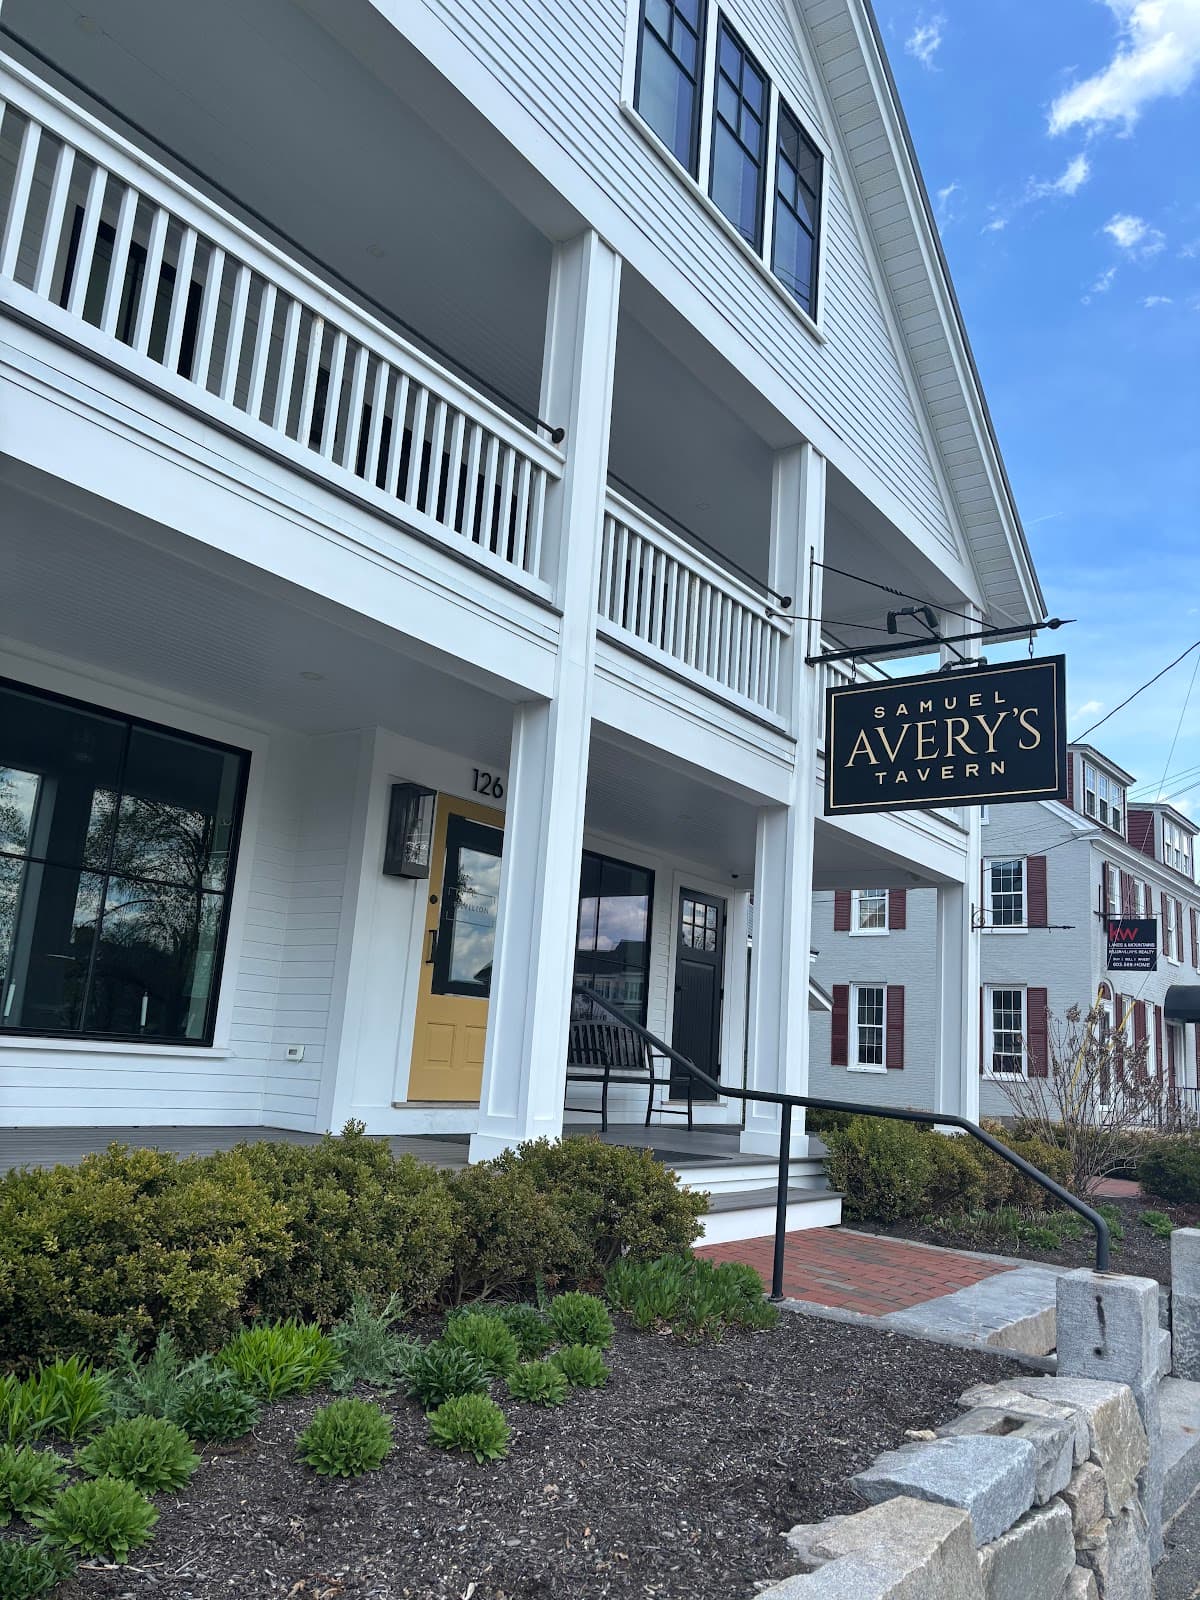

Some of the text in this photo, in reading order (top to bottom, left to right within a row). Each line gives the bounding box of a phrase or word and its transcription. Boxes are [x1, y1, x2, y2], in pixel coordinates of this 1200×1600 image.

[873, 690, 1006, 719] SAMUEL
[844, 707, 1042, 768] AVERY'S
[472, 768, 503, 799] 126
[874, 761, 1006, 785] TAVERN
